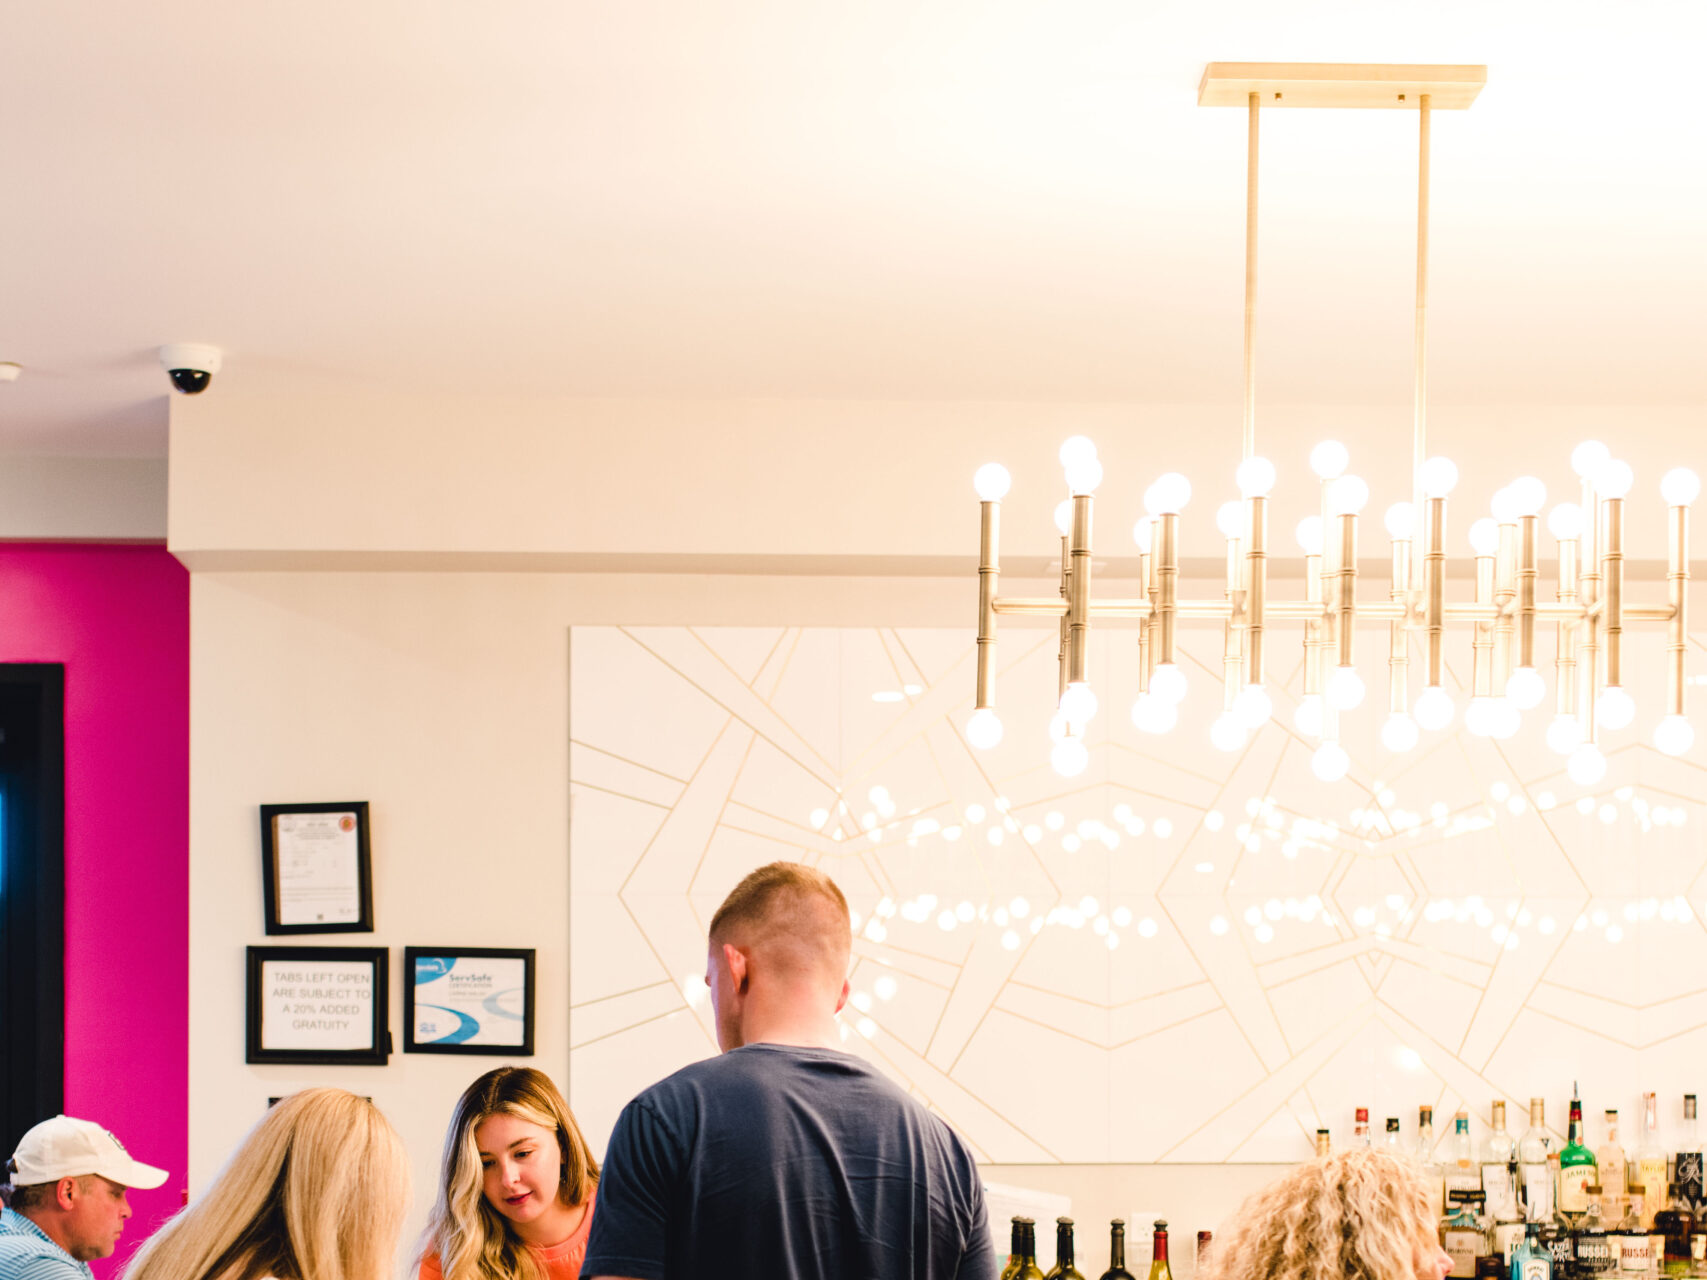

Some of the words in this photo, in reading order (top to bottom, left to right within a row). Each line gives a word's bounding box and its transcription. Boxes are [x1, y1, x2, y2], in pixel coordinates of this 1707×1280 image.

[274, 972, 302, 983] TABS
[306, 972, 333, 983] LEFT
[337, 973, 370, 984] OPEN
[273, 988, 295, 998] ARE
[299, 988, 351, 999] SUBJECT
[355, 989, 371, 999] TO
[282, 1004, 290, 1013] A
[293, 1004, 316, 1014] 20%
[319, 1004, 360, 1015] ADDED
[292, 1019, 349, 1030] GRATUITY
